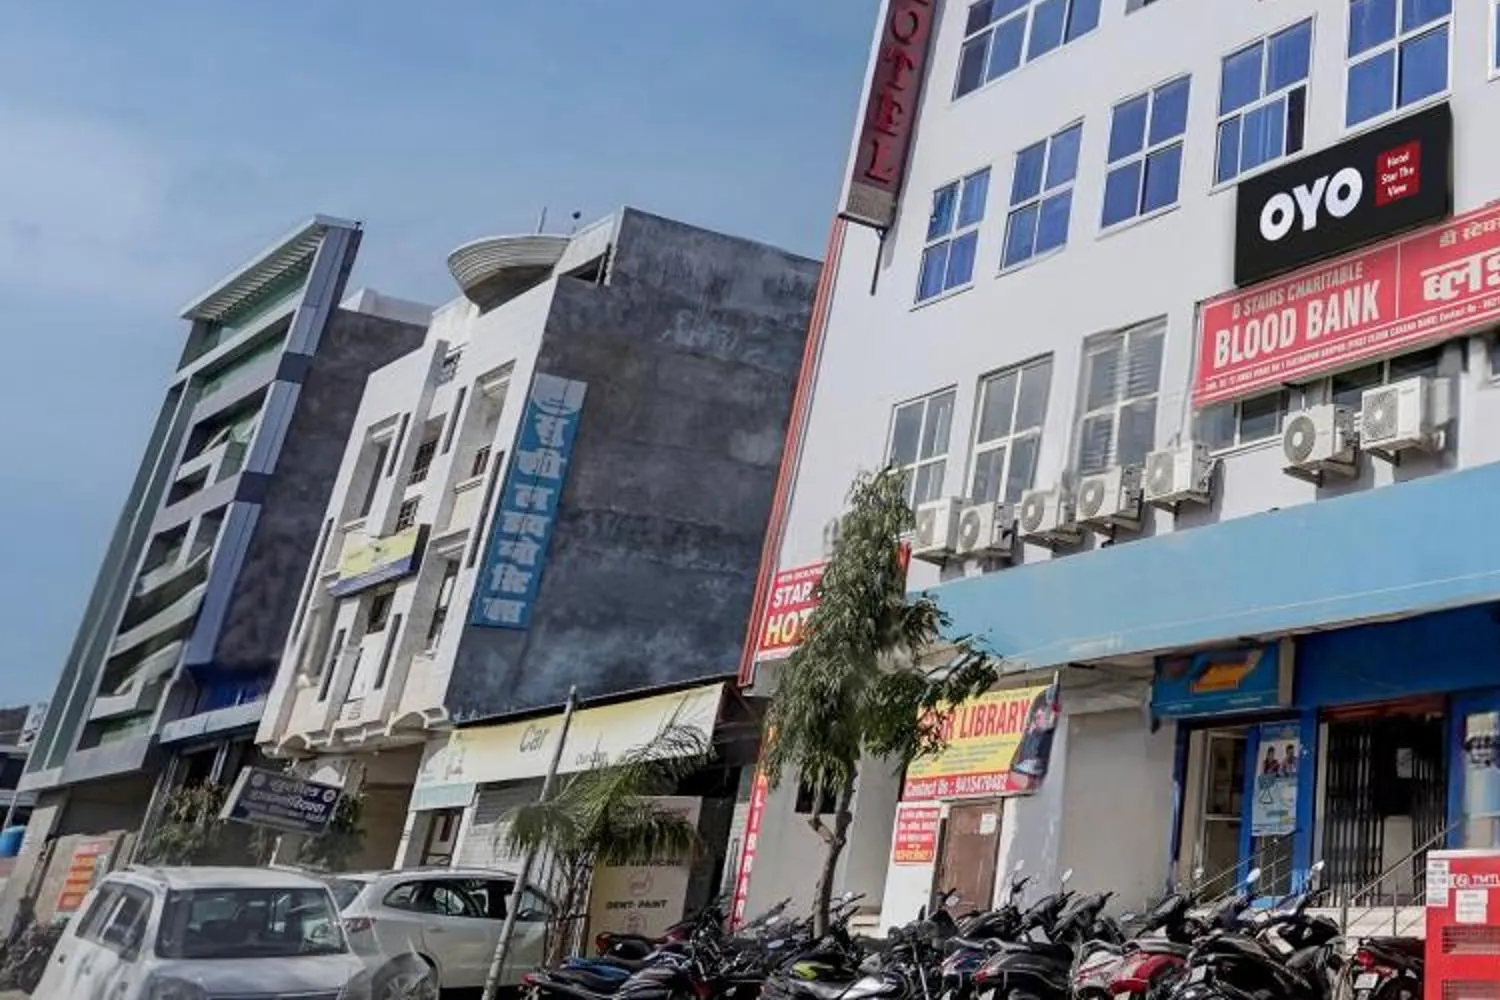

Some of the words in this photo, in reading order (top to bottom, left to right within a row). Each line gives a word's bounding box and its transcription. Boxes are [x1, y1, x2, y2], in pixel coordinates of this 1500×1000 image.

[1259, 167, 1364, 242] OYO
[1243, 288, 1289, 316] STAIRS
[1288, 261, 1364, 301] CHARITABLE
[1214, 307, 1297, 370] BLOOD
[1306, 279, 1381, 341] BANK
[763, 607, 814, 646] HOT
[959, 698, 1031, 738] LIBRARY
[736, 788, 765, 922] LIBRAR
